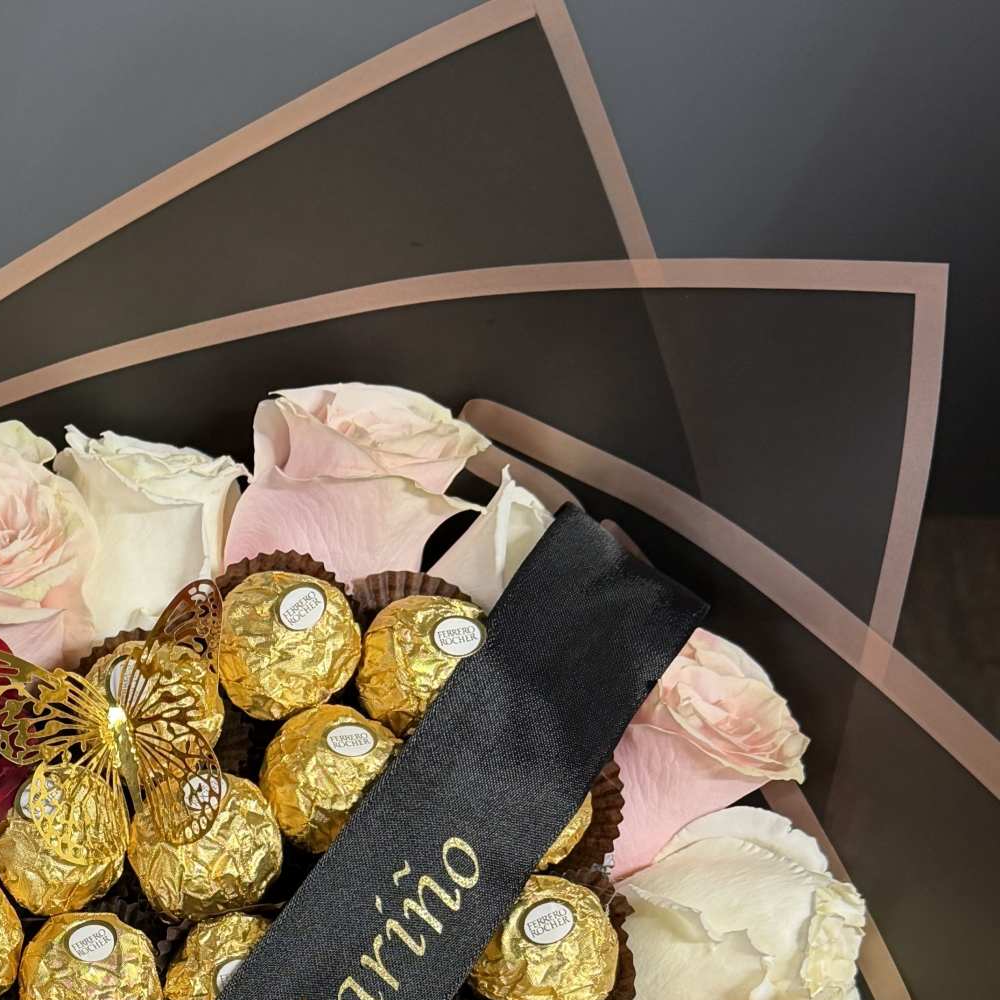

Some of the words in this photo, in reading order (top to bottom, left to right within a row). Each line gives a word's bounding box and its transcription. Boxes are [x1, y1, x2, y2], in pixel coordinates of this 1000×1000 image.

[283, 592, 315, 619] FERRERO
[288, 599, 321, 626] ROCHER
[438, 626, 476, 638] FERRERO
[440, 634, 478, 646] ROCHER
[330, 733, 368, 742] FERRERO
[332, 739, 370, 747] ROCHER
[527, 909, 567, 930] FERRERO
[531, 917, 569, 938] ROCHER
[72, 929, 106, 949] FERRERO
[76, 936, 110, 956] ROCHER
